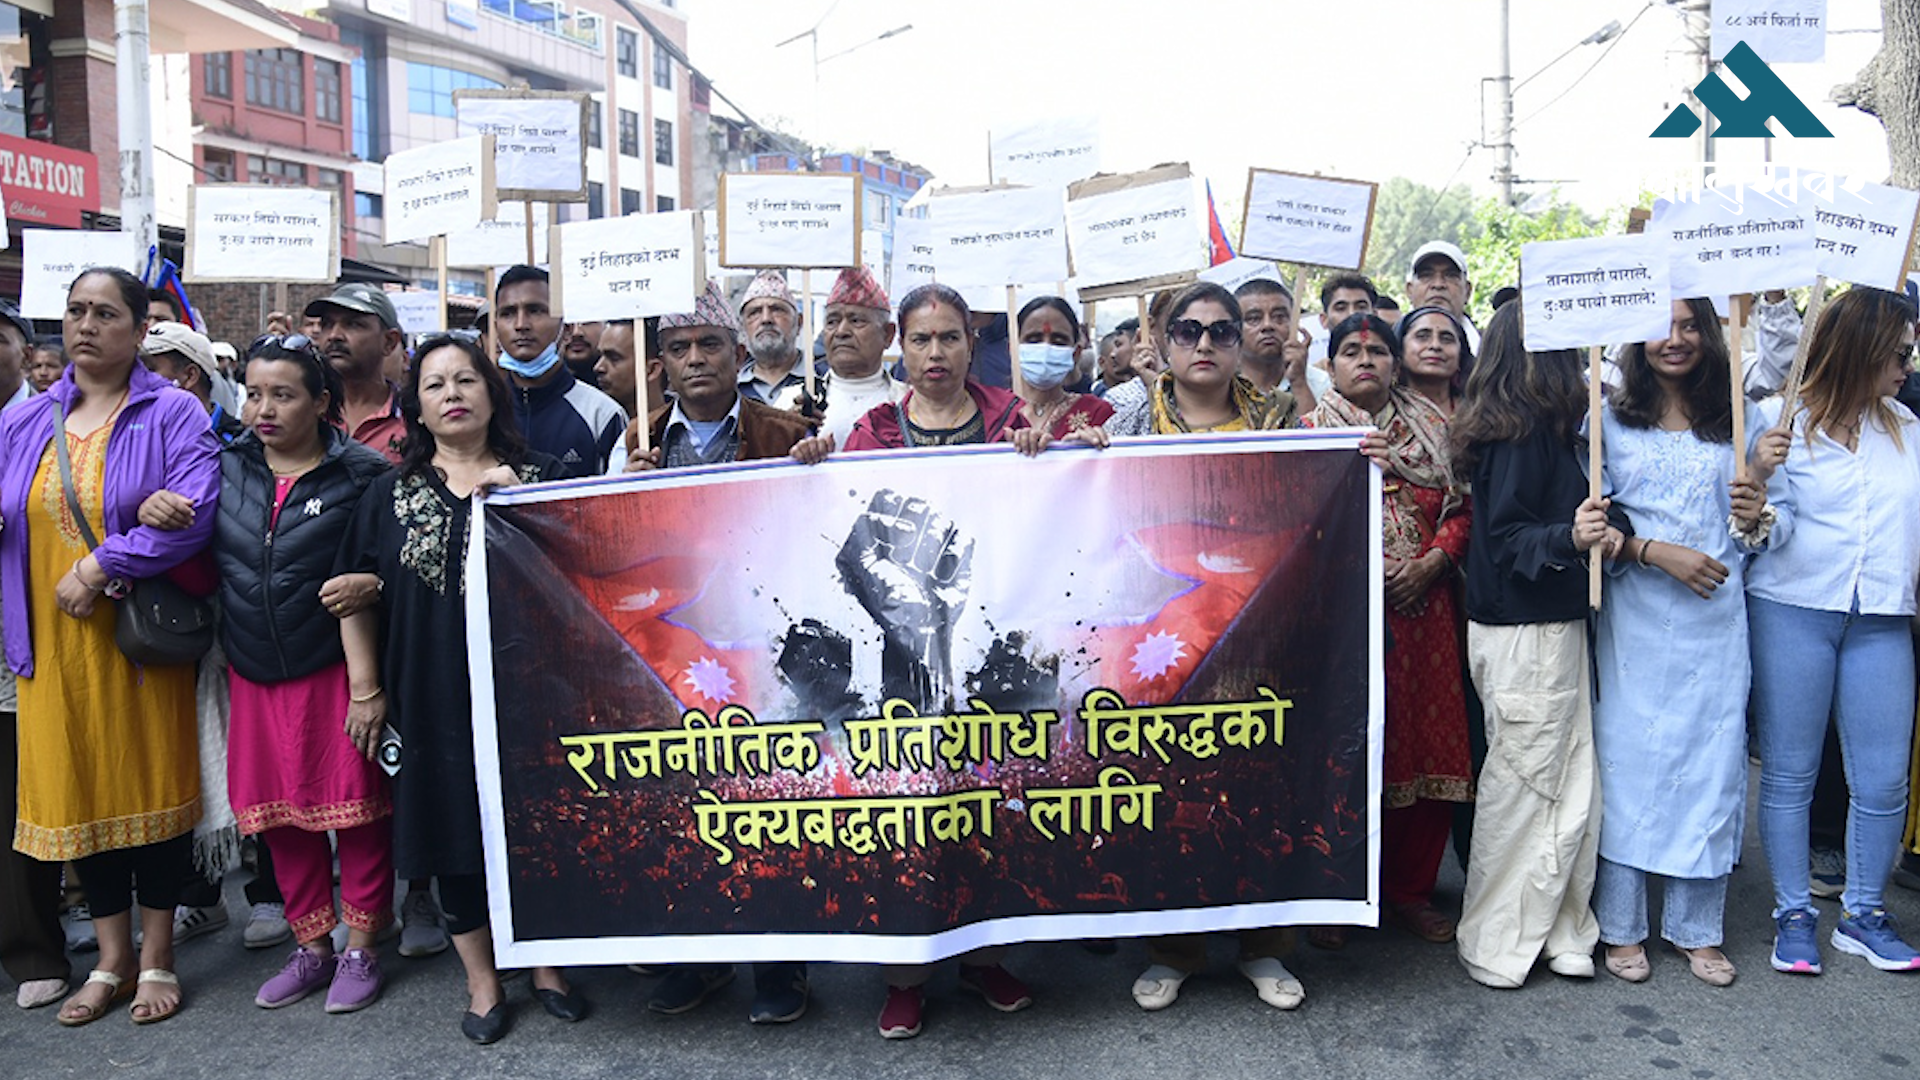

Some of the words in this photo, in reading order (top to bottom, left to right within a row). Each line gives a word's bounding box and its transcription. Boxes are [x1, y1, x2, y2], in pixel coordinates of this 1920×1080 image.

[1804, 17, 1820, 28] गर
[0, 149, 85, 198] TATION
[1672, 222, 1734, 241] राजनीतिक
[1737, 215, 1804, 237] प्रतिशोधको
[579, 251, 596, 277] दुई
[599, 246, 652, 267] तिहाइको
[1697, 247, 1723, 262] खेल
[1730, 247, 1754, 259] बन्द
[1839, 242, 1858, 258] गर
[634, 278, 651, 291] गर
[1545, 266, 1605, 287] तानाशाही
[1543, 298, 1574, 320] दुःख
[1577, 291, 1607, 310] पायो
[304, 498, 322, 516] NY
[560, 707, 824, 792] राजनीतिक
[844, 697, 1057, 777] प्रतिशोध
[1080, 687, 1293, 764] विरुद्धको
[693, 789, 1001, 865] ऐक्यबद्धताका
[1026, 767, 1162, 840] लागि
